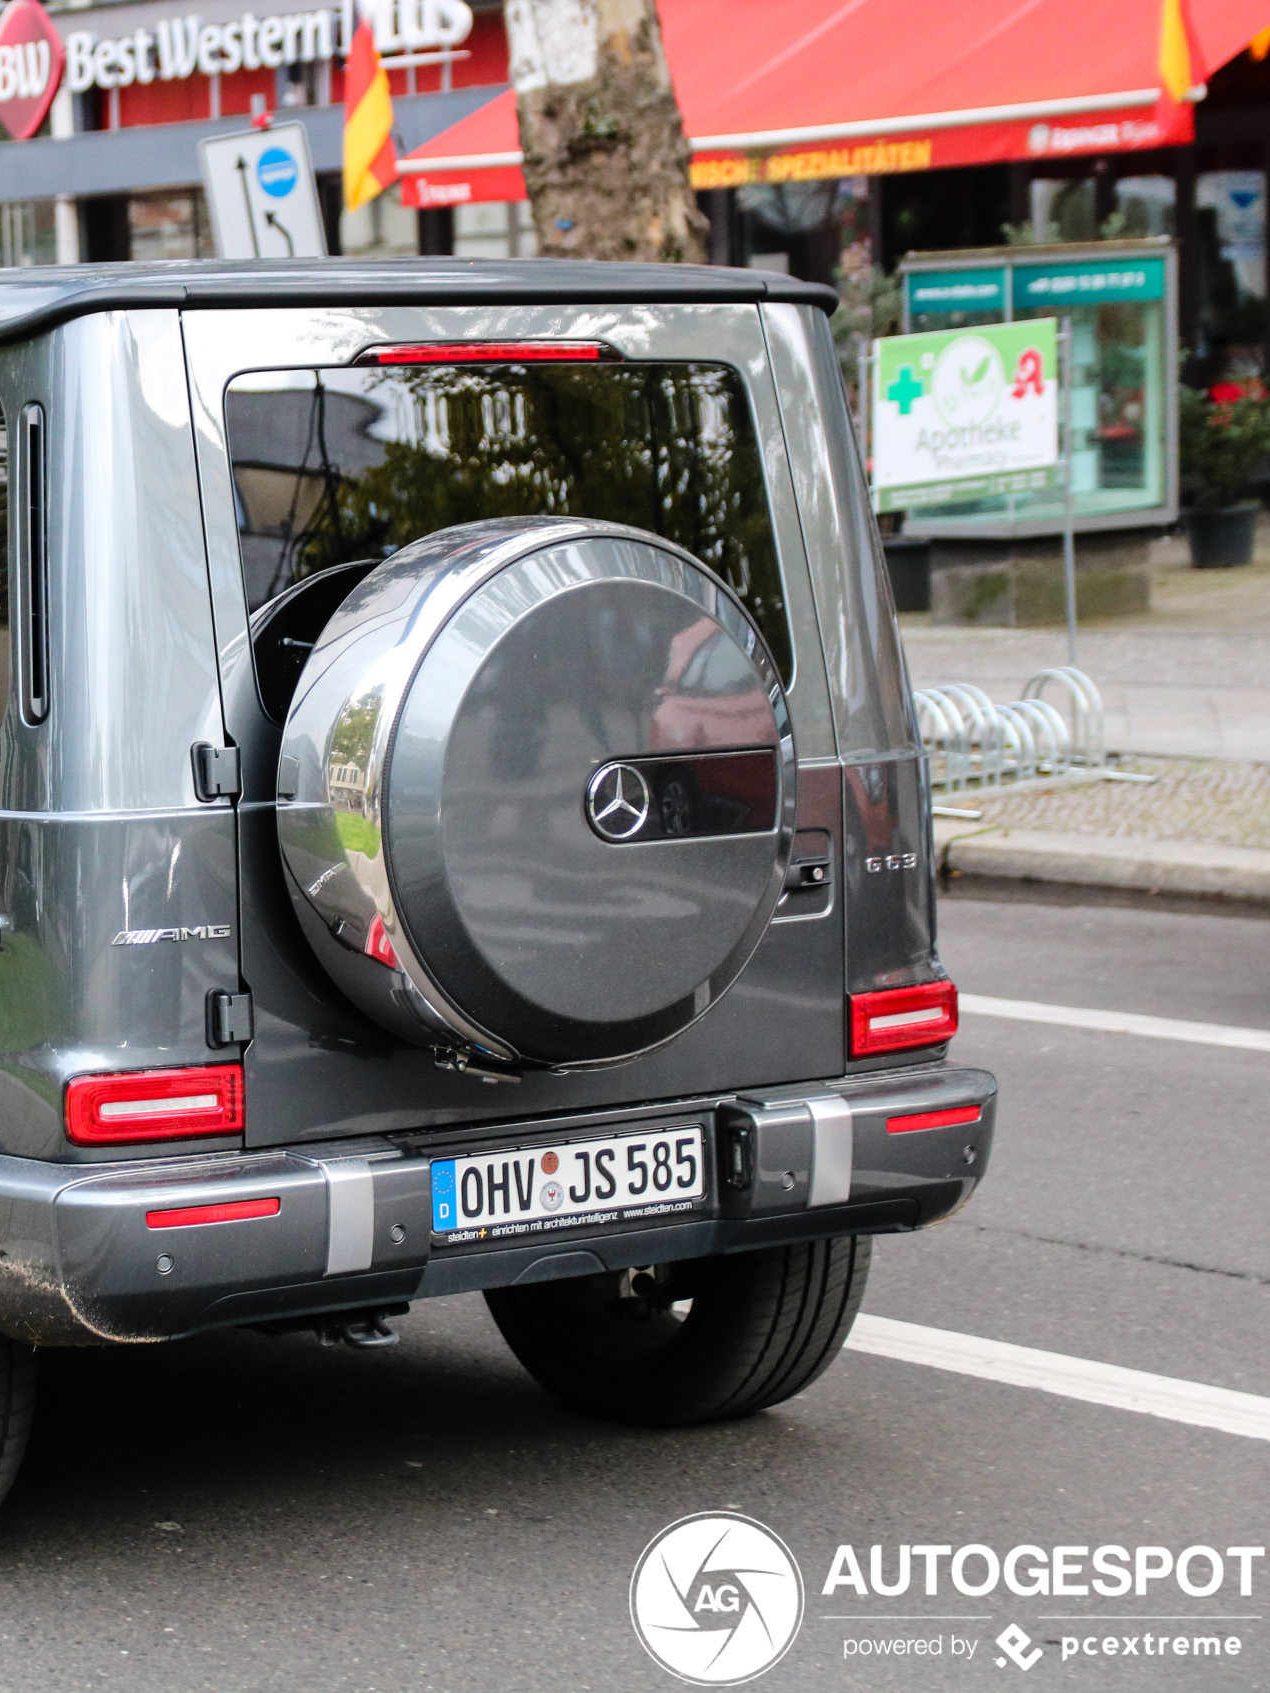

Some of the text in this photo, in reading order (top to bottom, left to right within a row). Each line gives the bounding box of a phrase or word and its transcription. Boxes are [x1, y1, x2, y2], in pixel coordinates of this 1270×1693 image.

[66, 30, 156, 93] Best
[156, 9, 332, 80] Western
[765, 138, 932, 181] SPEZIALITÄTEN
[916, 416, 1023, 454] Apotheke
[885, 852, 918, 871] 63
[158, 924, 231, 943] AMG
[460, 1158, 536, 1219] OHV
[568, 1148, 618, 1203] JS
[626, 1137, 697, 1195] 585
[439, 1203, 451, 1219] D
[491, 1223, 530, 1237] einrichten
[530, 1220, 543, 1232] mit
[623, 1200, 693, 1219] www.steidten.com
